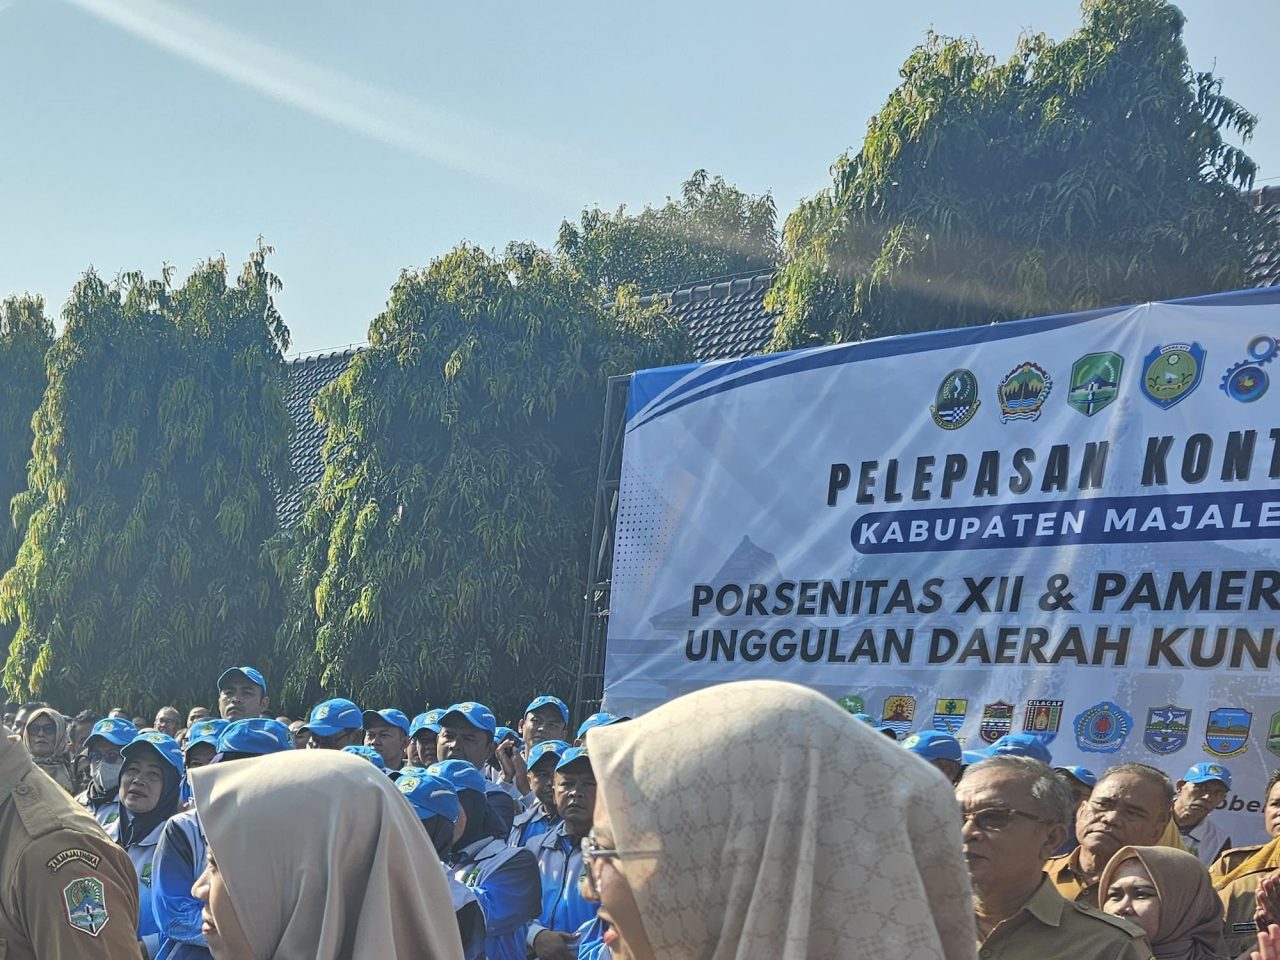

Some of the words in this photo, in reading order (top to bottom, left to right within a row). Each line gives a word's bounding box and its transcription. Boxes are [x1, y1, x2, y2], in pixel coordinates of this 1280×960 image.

[827, 440, 1111, 506] PELEPASAN
[858, 510, 1086, 545] KABUPATEN
[1103, 501, 1280, 532] MAJALE
[691, 577, 945, 617] PORSENITAS
[955, 574, 1025, 614] XII
[1038, 573, 1076, 612] &
[1091, 569, 1280, 611] PAMER
[685, 628, 915, 664] UNGGULAN
[927, 625, 1132, 666] DAERAH
[1147, 627, 1280, 669] KUN
